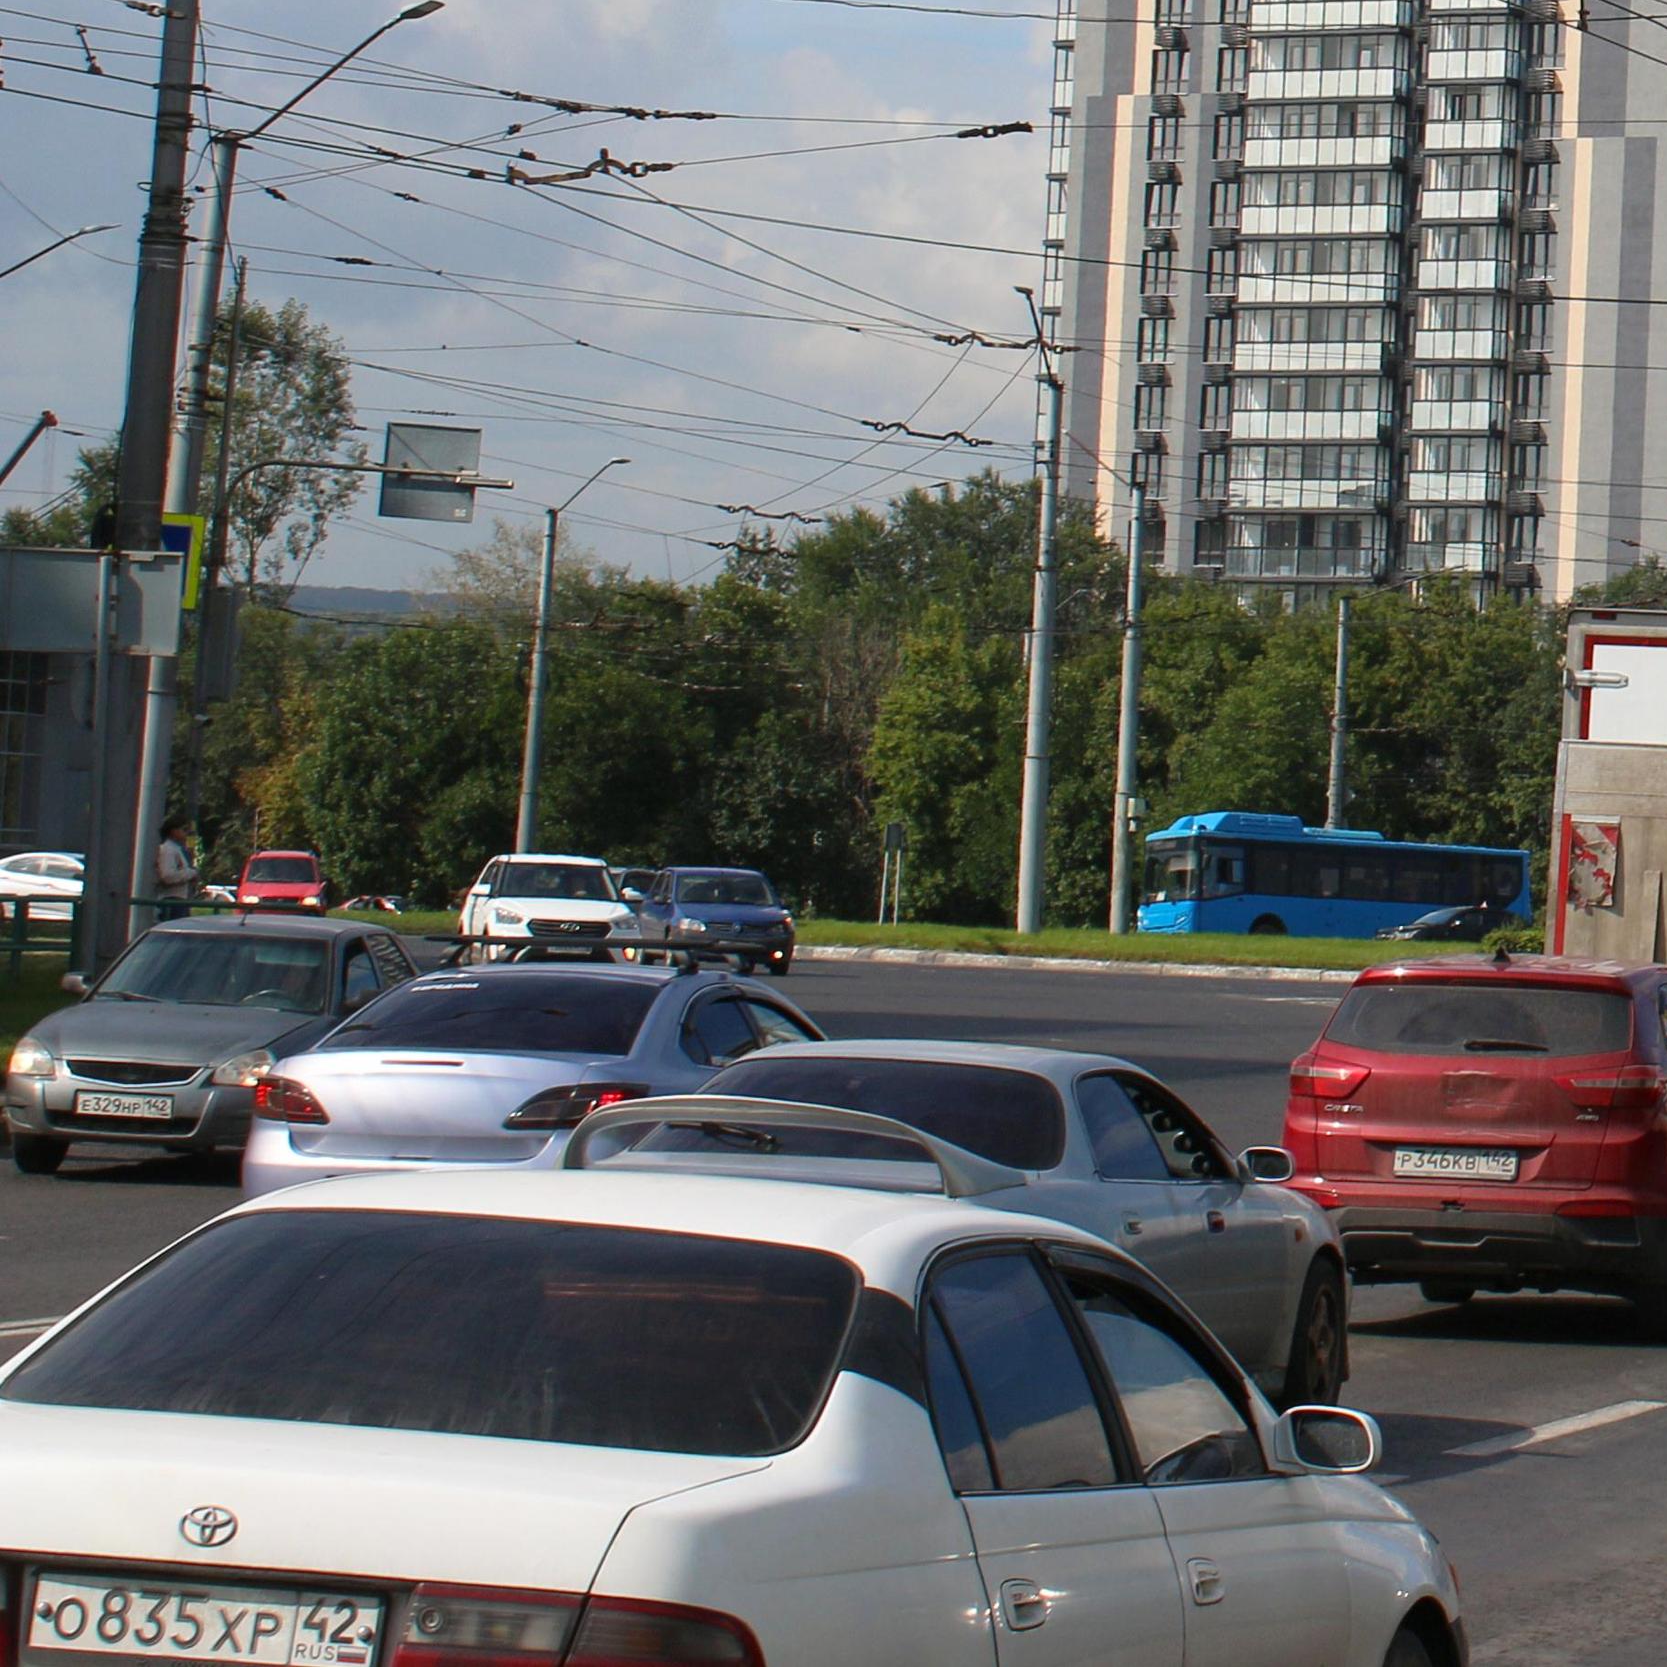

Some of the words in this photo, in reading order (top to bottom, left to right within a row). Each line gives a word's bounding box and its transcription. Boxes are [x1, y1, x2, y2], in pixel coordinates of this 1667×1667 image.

[81, 1097, 141, 1114] Е329НР
[144, 1099, 168, 1112] 142
[1400, 1149, 1477, 1171] Р346КВ
[1483, 1151, 1514, 1167] 142
[53, 1588, 281, 1655] О835ХР
[302, 1597, 359, 1644] 42
[294, 1642, 336, 1661] RUS
